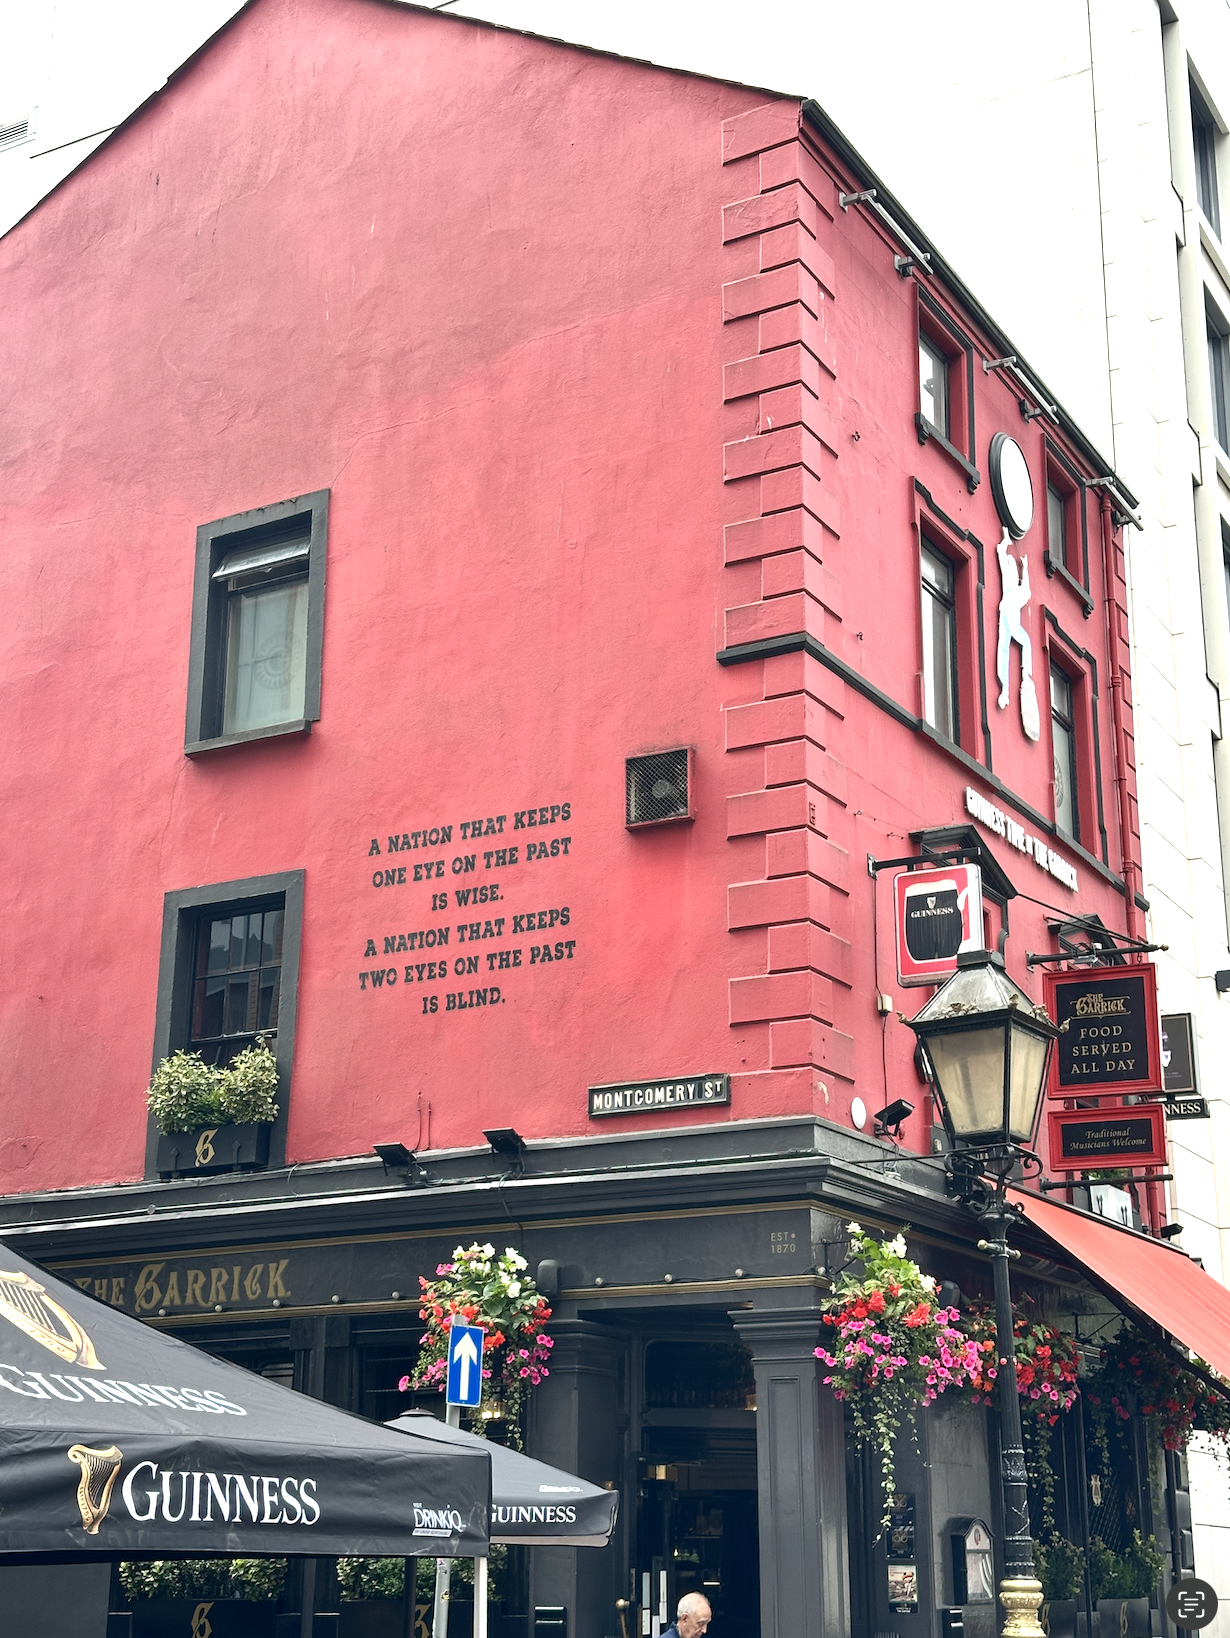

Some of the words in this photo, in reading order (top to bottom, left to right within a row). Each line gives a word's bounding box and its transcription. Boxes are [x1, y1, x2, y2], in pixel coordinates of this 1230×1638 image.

[368, 839, 381, 856] A
[388, 826, 453, 853] NATION
[460, 815, 507, 840] THAT
[514, 803, 571, 830] KEEPS
[372, 867, 406, 888] ONE
[413, 860, 445, 882] EYE
[452, 855, 476, 874] ON
[484, 847, 518, 869] THE
[526, 837, 571, 861] PAST
[432, 893, 448, 911] IS
[455, 884, 504, 907] WISE.
[911, 907, 954, 918] GUINNESS
[364, 939, 377, 957] A
[384, 927, 450, 954] NATION
[457, 918, 505, 943] THAT
[512, 907, 571, 934] KEEPS
[359, 968, 398, 990] TWO
[404, 961, 448, 983] EYES
[454, 956, 480, 976] ON
[487, 949, 522, 971] THE
[530, 941, 576, 964] PAST
[422, 996, 439, 1014] IS
[446, 987, 506, 1011] BLIND.
[1076, 996, 1127, 1016] GARRICK
[1087, 994, 1104, 1003] THE
[1080, 1025, 1122, 1039] FOOD
[1072, 1042, 1132, 1057] SERVED
[1071, 1063, 1100, 1075] ALL
[1106, 1059, 1135, 1072] DAY
[1085, 1127, 1131, 1140] Traditional
[1070, 1140, 1110, 1151] Musicians
[1112, 1138, 1147, 1148] Welcome
[771, 1243, 796, 1254] 1870
[0, 1363, 248, 1417] GUINNESS
[122, 1461, 321, 1526] GUINNESS
